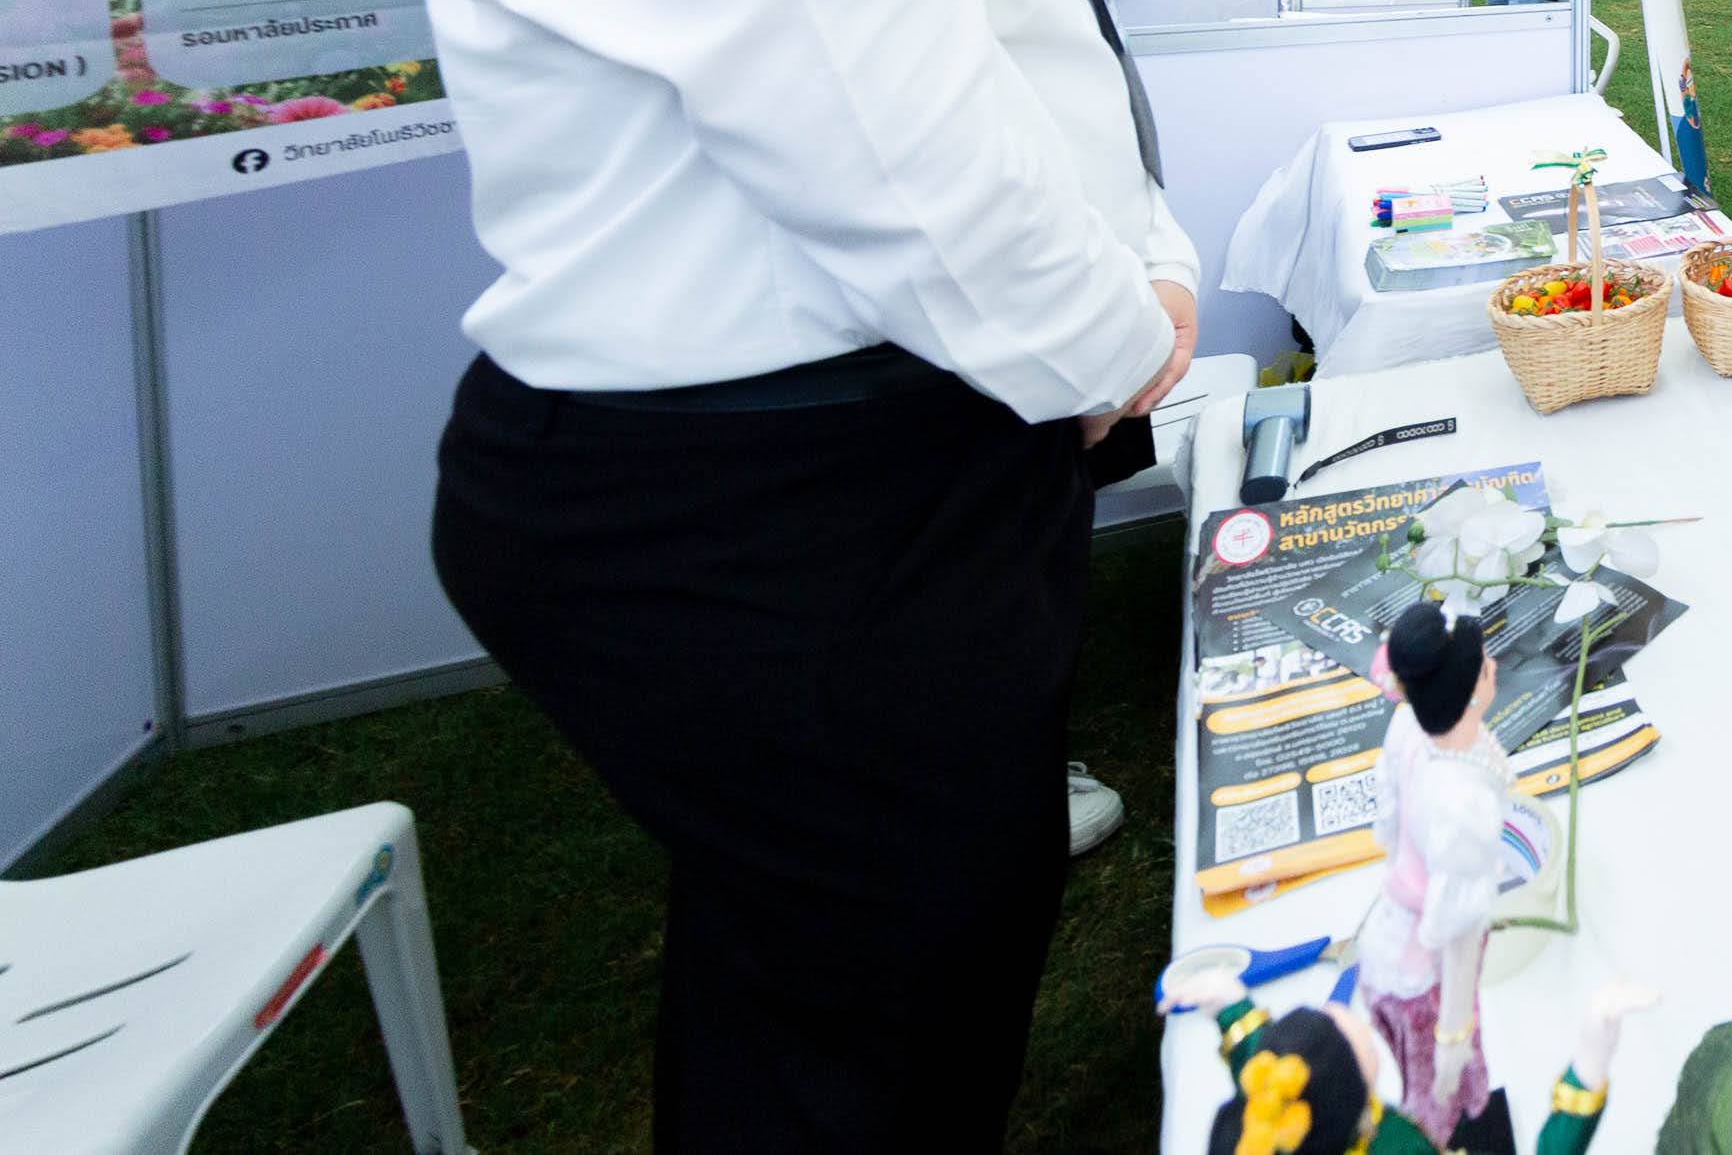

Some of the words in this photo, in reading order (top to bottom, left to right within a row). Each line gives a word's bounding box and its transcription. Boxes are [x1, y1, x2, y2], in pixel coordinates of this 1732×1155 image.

[179, 10, 379, 47] รอมหาลัยประกาศ
[1308, 606, 1373, 645] CCAS
